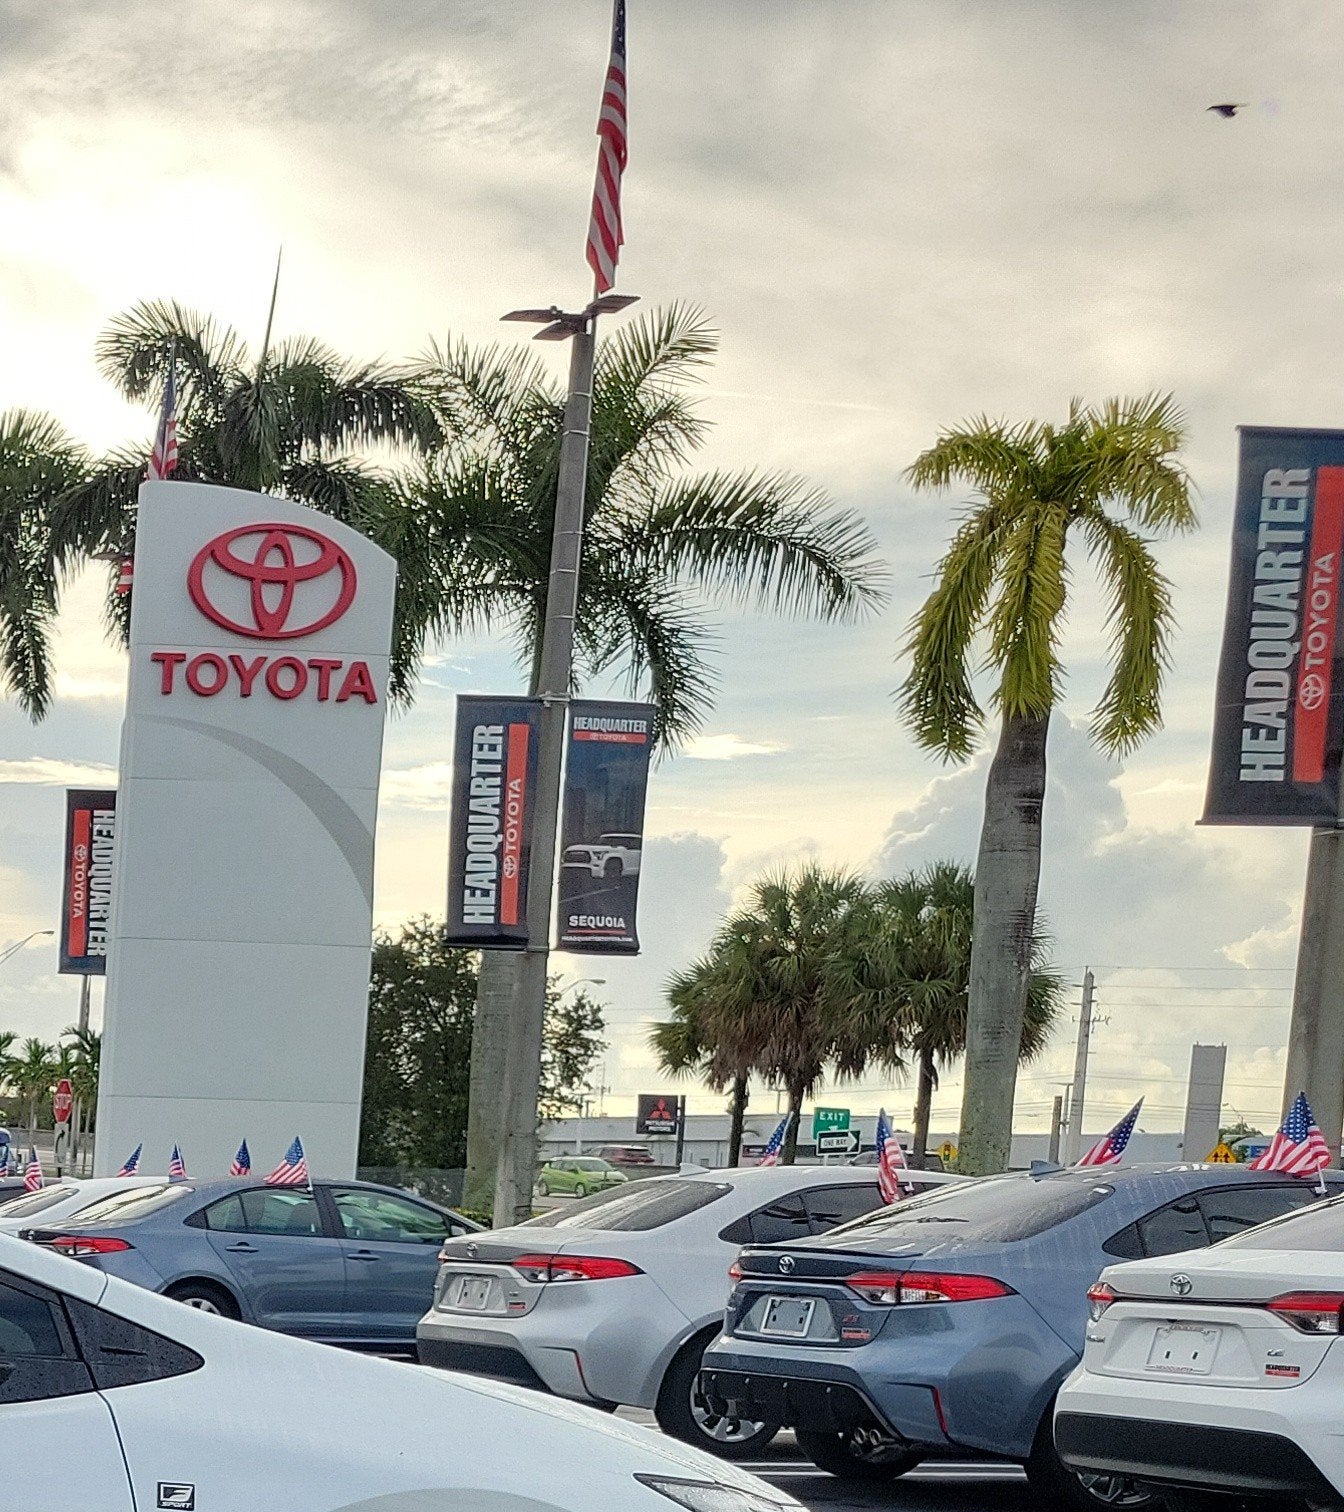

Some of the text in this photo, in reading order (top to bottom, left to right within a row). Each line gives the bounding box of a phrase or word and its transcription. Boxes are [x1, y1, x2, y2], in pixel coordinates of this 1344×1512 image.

[1239, 466, 1312, 783] HEADQUARTER
[1305, 552, 1336, 670] TOYOTA
[150, 651, 378, 704] TOYOTA
[573, 716, 647, 733] HEADQUARTER
[462, 724, 504, 925] HEADQUARTER
[505, 778, 522, 852] TOYOTA
[72, 862, 85, 918] TOYOTA
[87, 809, 115, 956] HEADQUARTER
[568, 915, 626, 928] SEQUOIA
[819, 1111, 845, 1122] EXIT
